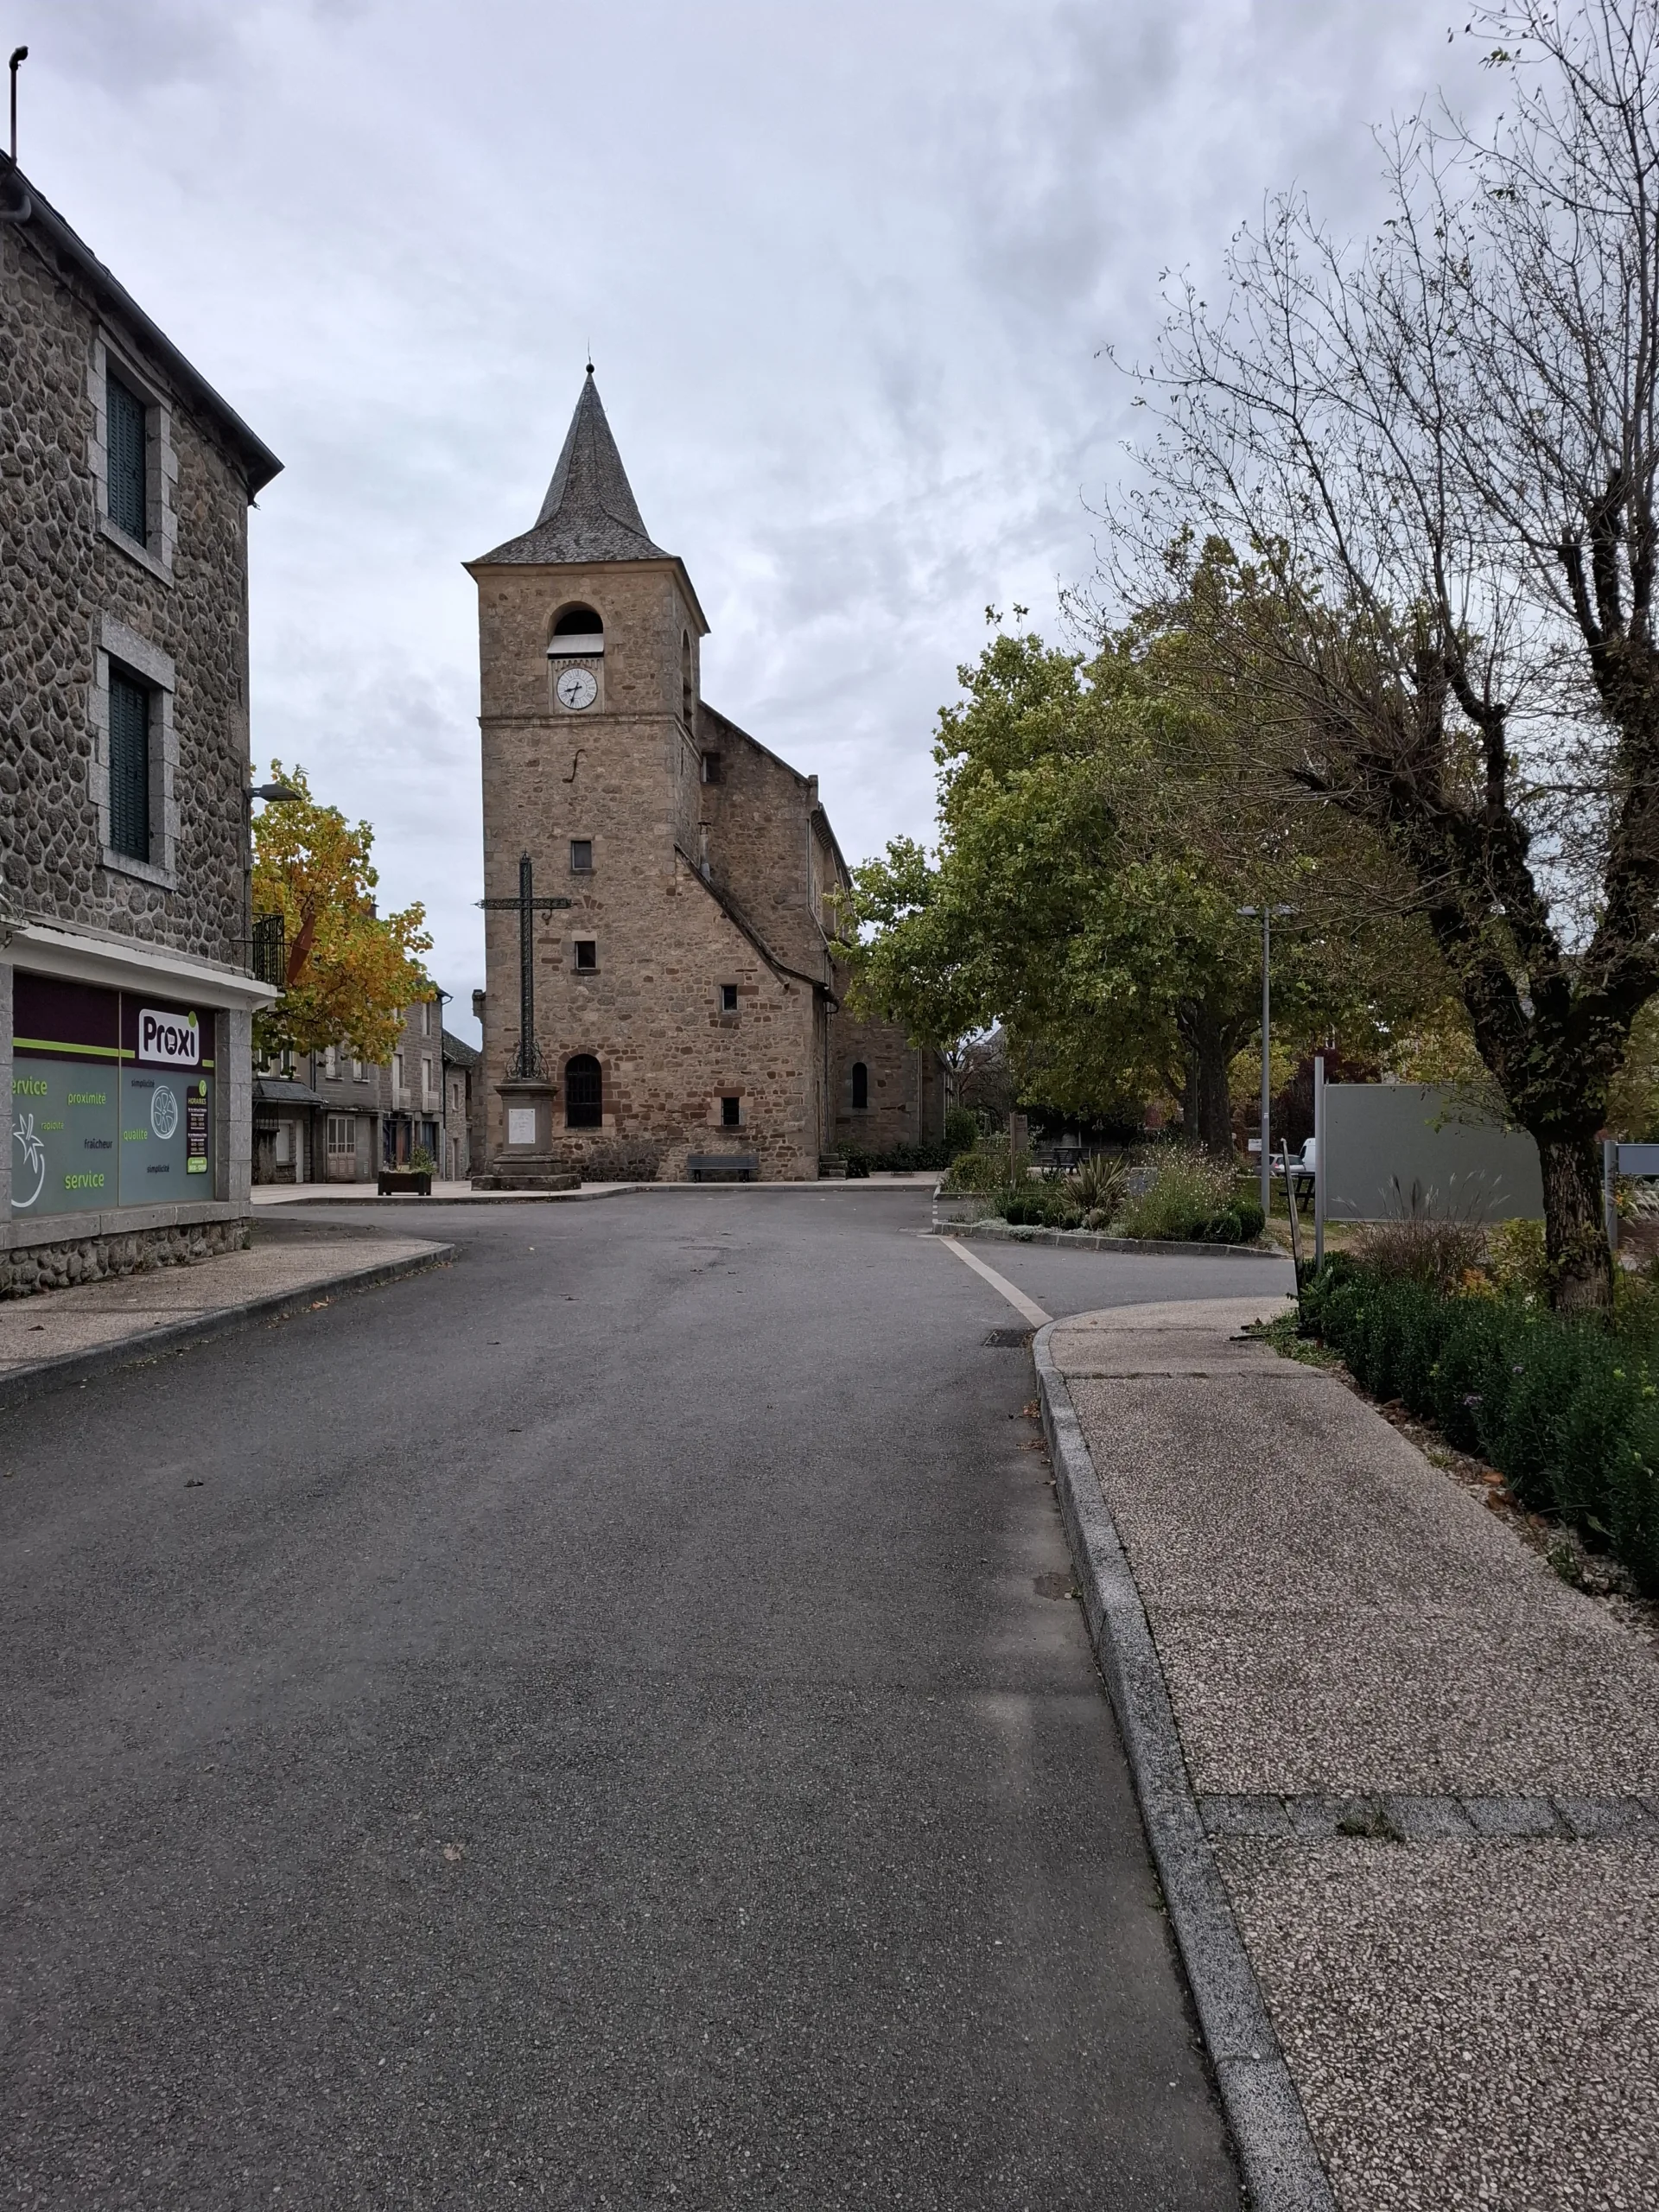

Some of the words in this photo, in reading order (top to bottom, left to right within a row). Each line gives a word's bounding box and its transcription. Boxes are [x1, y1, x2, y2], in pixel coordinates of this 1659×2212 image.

[143, 1011, 197, 1058] Proxi
[12, 1077, 48, 1096] ervice
[131, 1079, 155, 1088] simplicité
[67, 1092, 105, 1105] proximité
[124, 1129, 148, 1141] qualité
[84, 1138, 112, 1149] fraîcheur
[147, 1165, 169, 1173] simplicité
[65, 1171, 104, 1189] service
